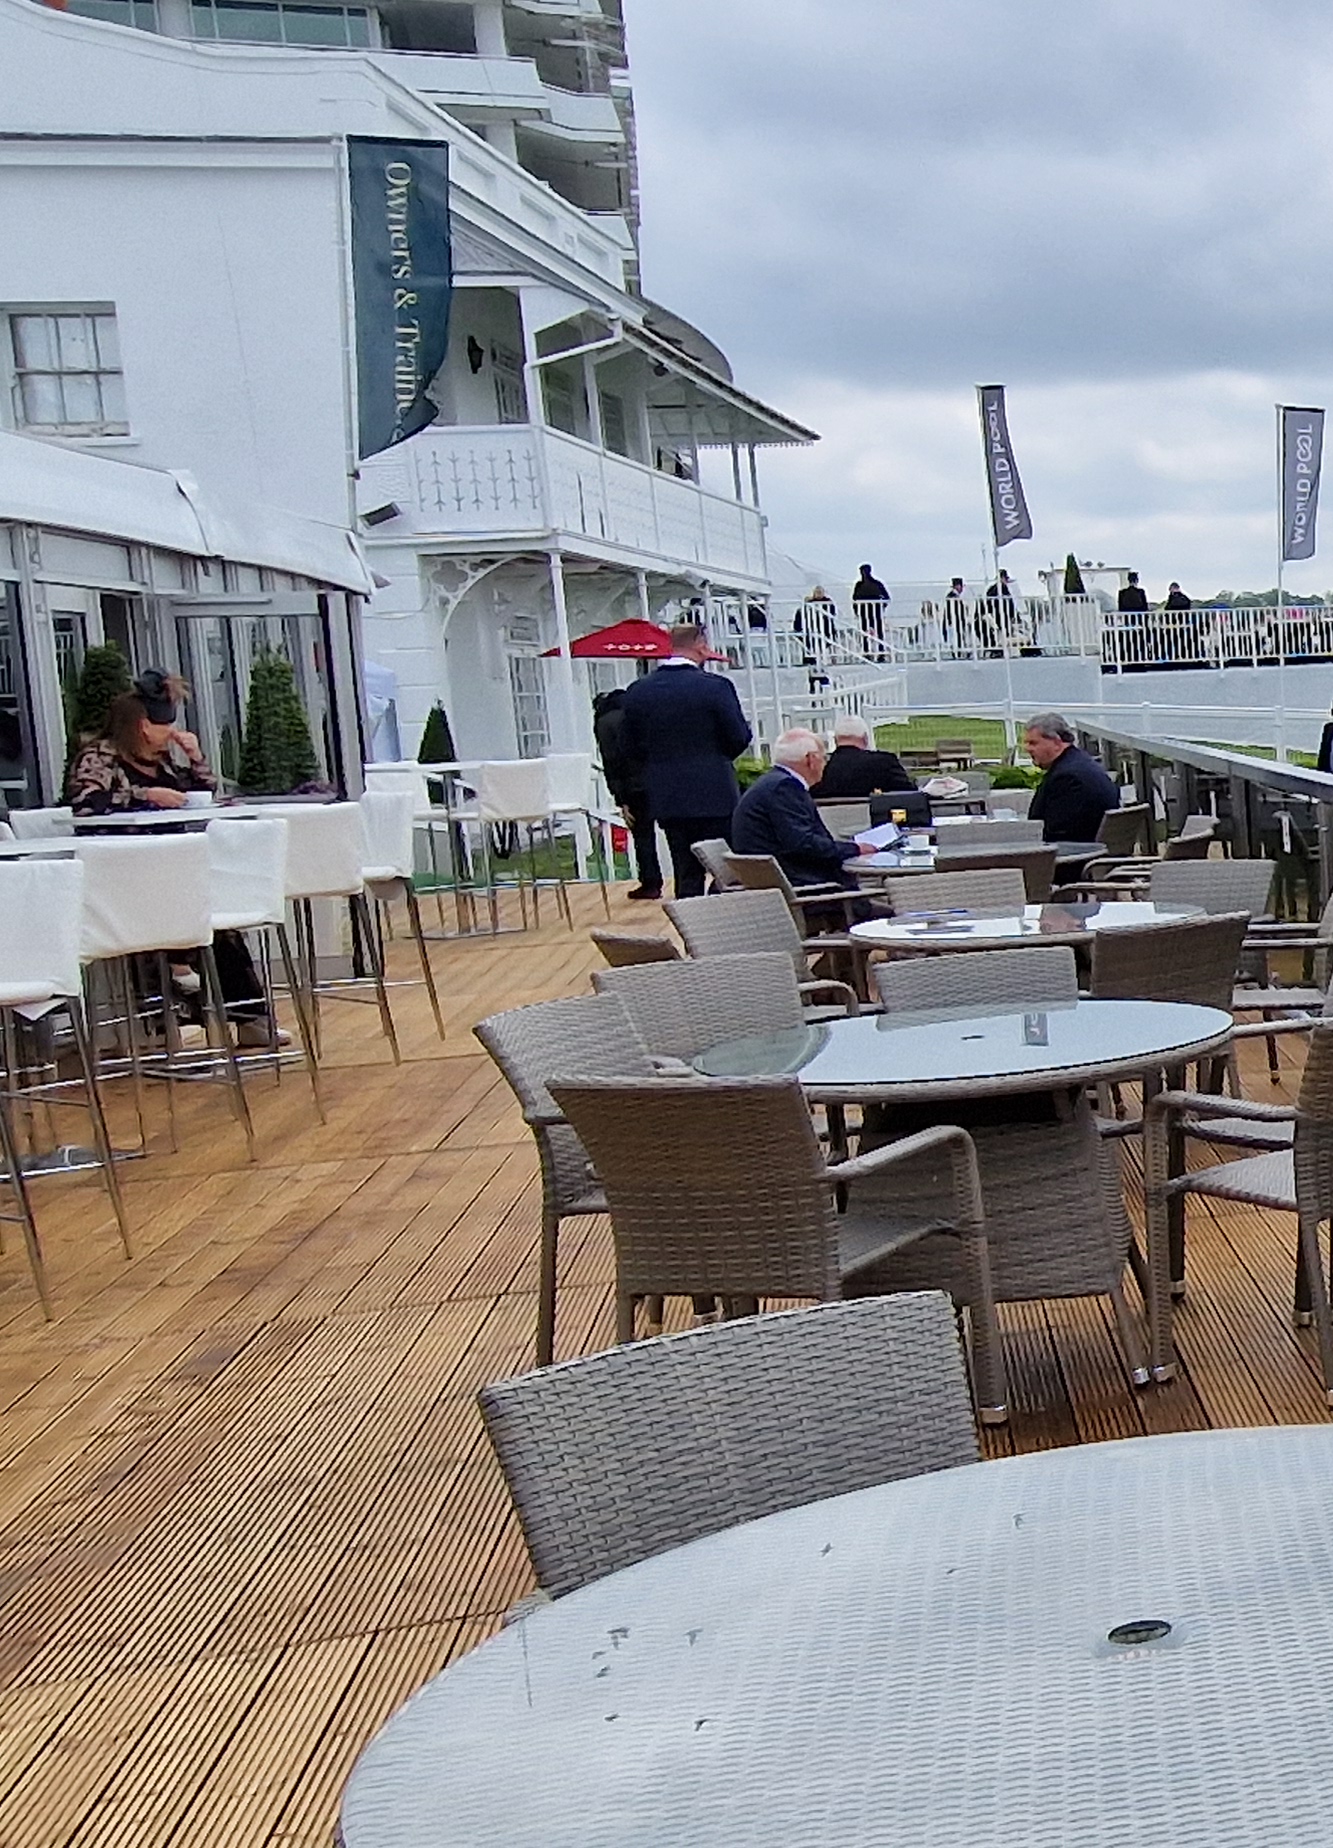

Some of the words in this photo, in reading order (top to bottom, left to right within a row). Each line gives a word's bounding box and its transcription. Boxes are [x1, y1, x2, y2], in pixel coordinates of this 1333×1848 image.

[384, 161, 413, 281] Owners
[393, 291, 419, 309] &
[391, 319, 423, 444] Train
[987, 401, 1006, 453] POOL
[1296, 424, 1313, 474] POOL
[995, 457, 1020, 530] WORLD
[1292, 479, 1311, 544] WORLD
